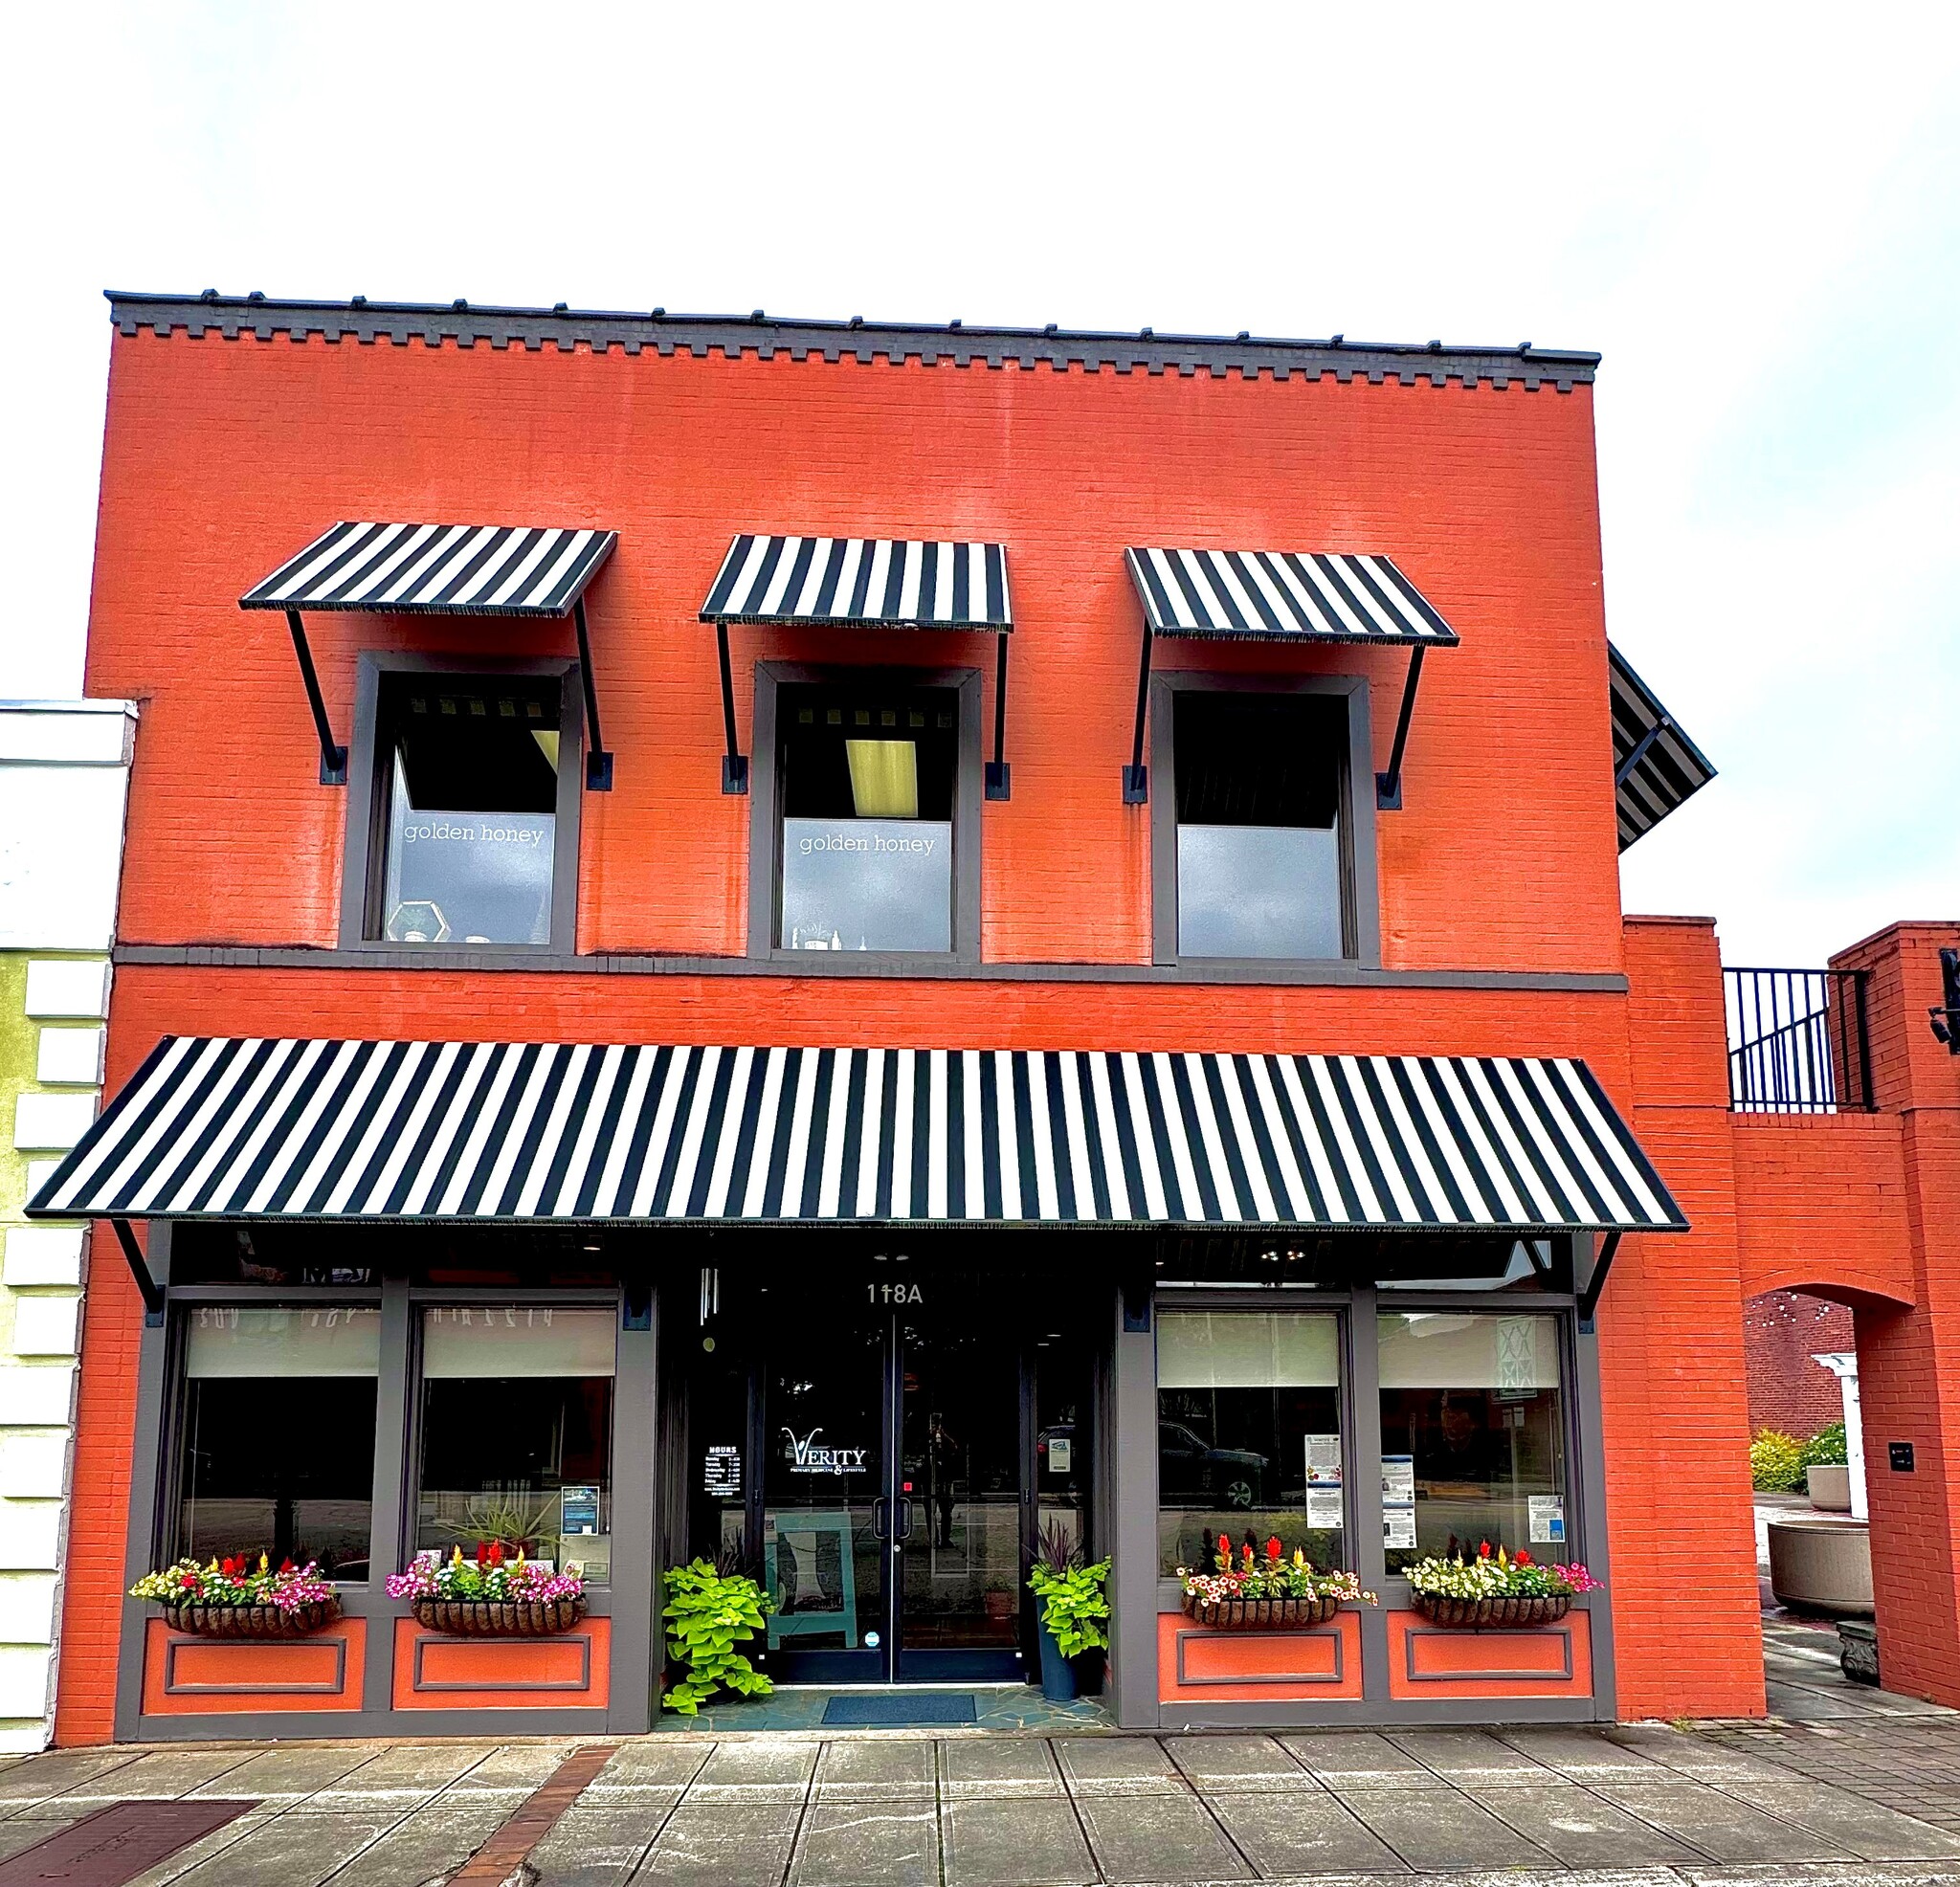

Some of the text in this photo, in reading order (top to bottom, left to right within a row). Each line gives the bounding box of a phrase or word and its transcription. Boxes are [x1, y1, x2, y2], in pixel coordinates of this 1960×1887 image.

[404, 822, 545, 848] golden honey
[799, 833, 936, 856] golden honey
[867, 1283, 924, 1304] 118A
